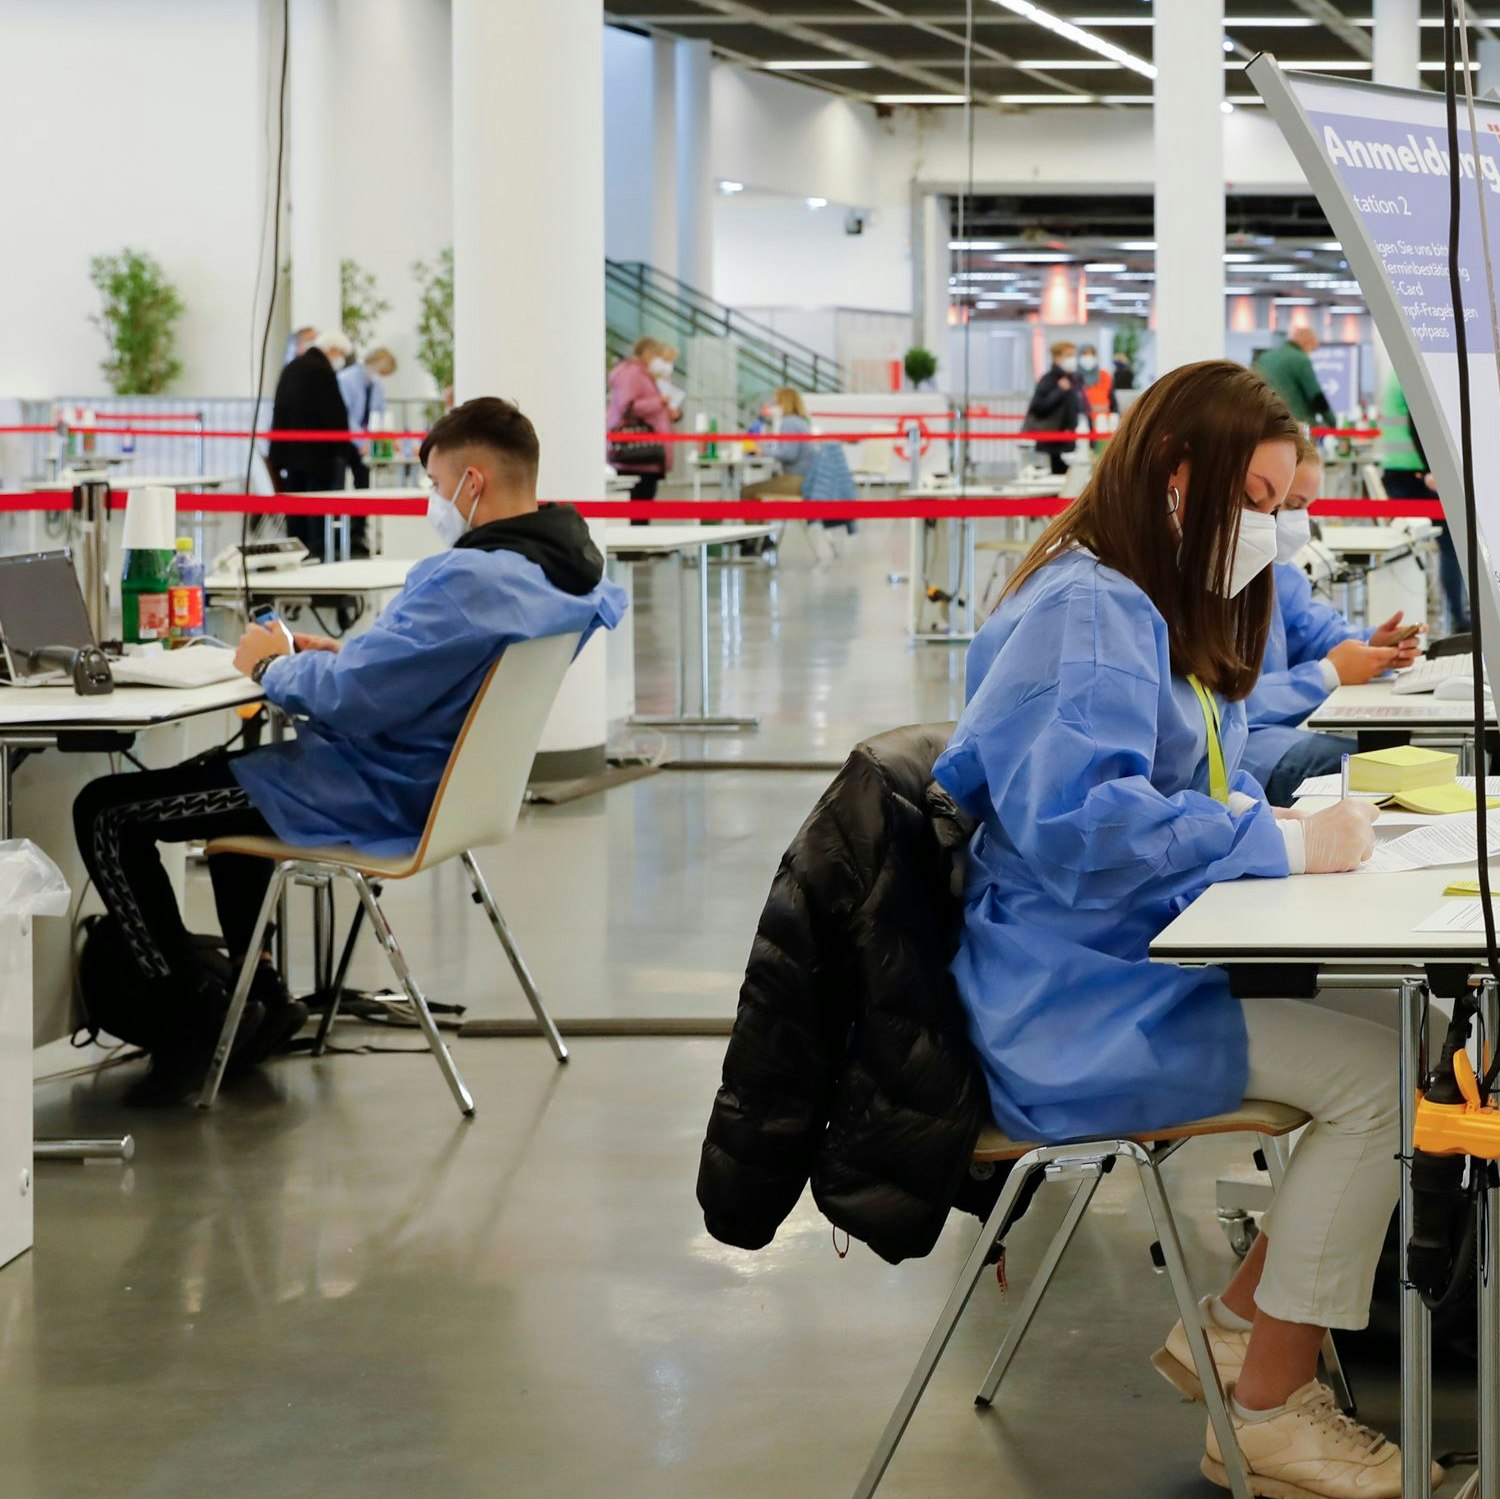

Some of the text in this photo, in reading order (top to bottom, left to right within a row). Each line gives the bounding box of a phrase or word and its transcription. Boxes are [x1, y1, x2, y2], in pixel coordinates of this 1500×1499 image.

[1353, 194, 1412, 215] tation 2
[1397, 240, 1415, 255] Sie
[1415, 244, 1432, 256] uns
[1430, 242, 1449, 256] bitt
[1391, 281, 1424, 296] -Card
